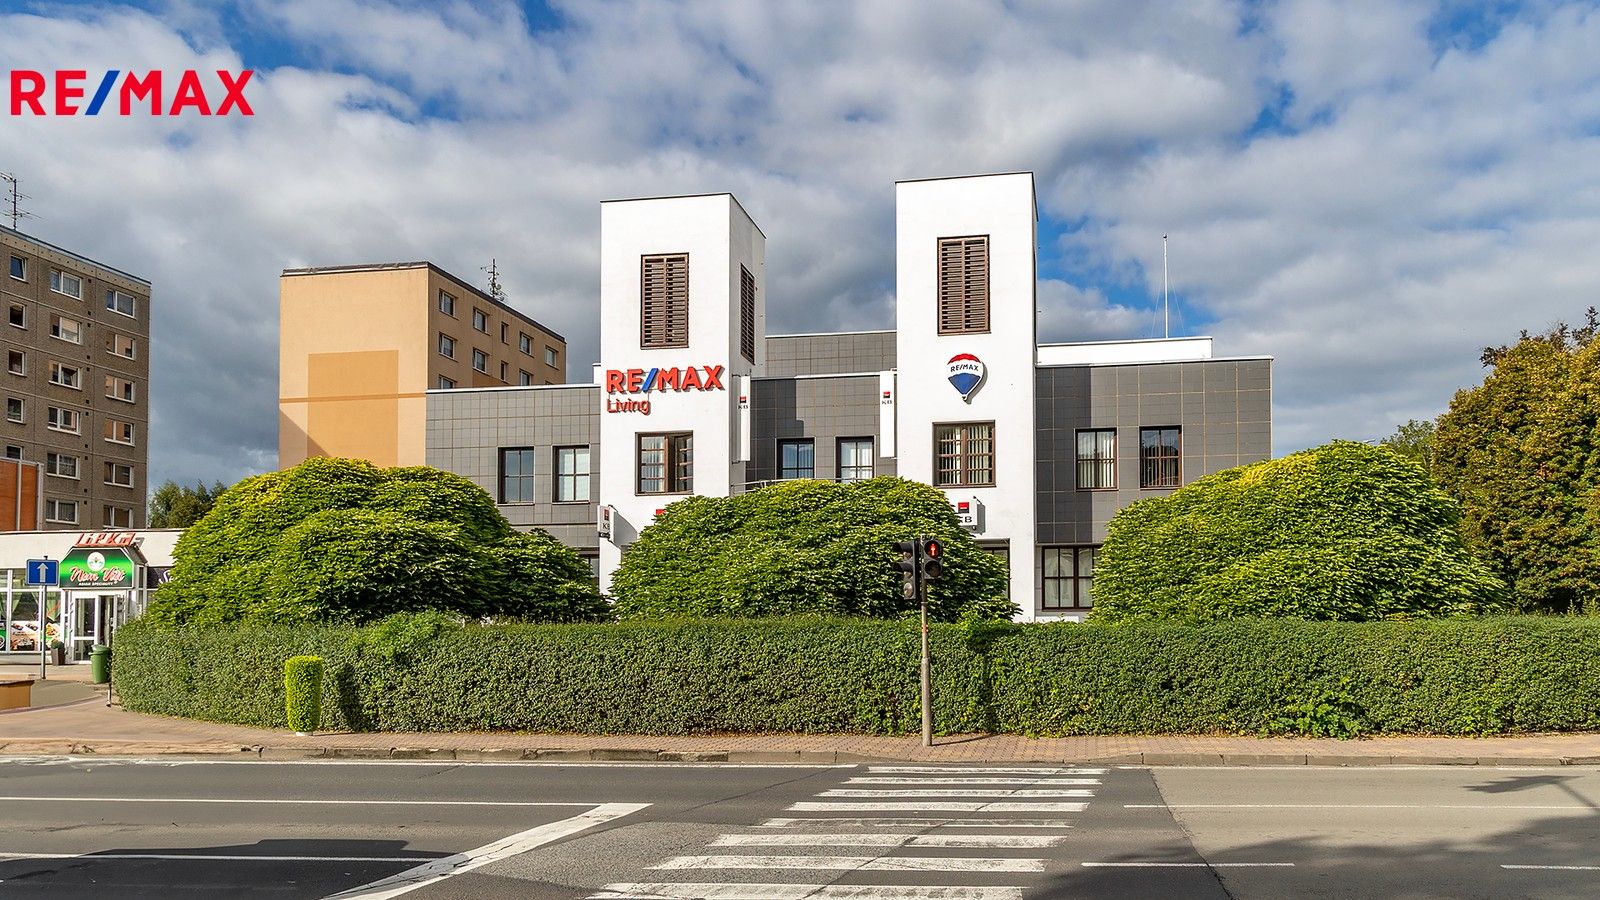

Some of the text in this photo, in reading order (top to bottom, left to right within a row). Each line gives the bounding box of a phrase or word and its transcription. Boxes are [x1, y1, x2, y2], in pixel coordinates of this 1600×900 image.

[950, 364, 979, 372] RE/MAX
[606, 365, 724, 393] RE/MAX
[607, 398, 650, 415] Living
